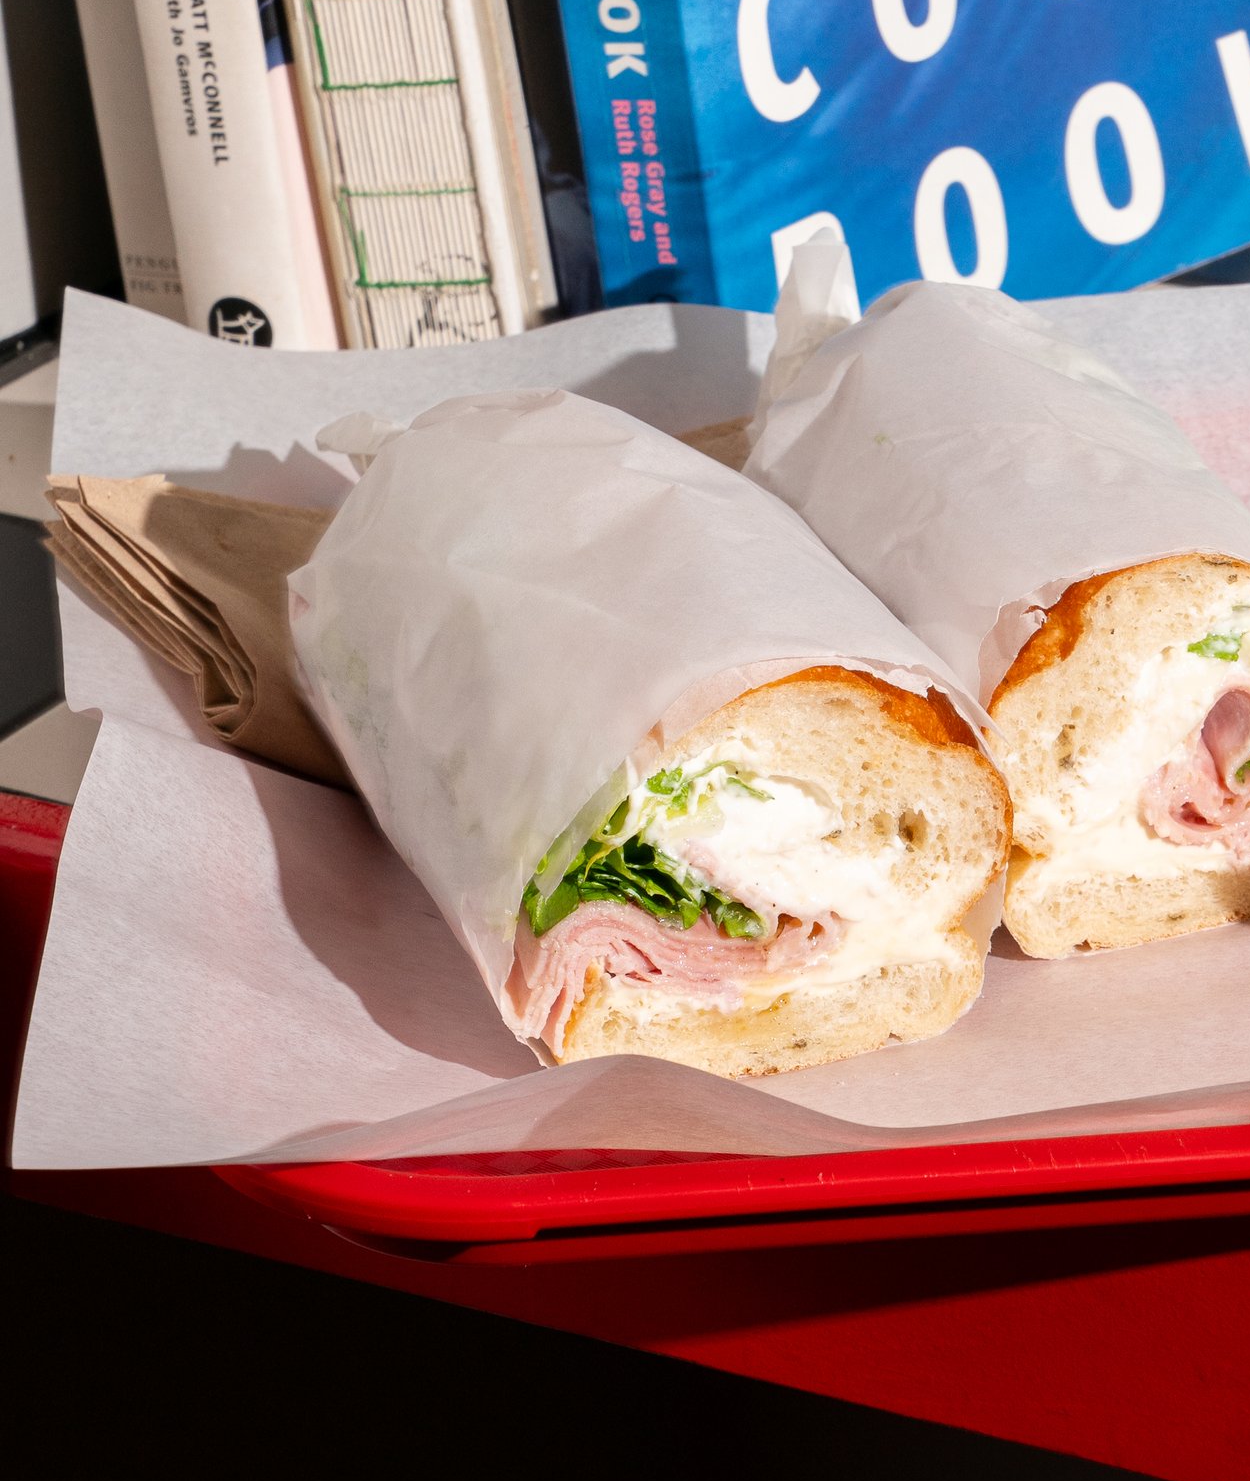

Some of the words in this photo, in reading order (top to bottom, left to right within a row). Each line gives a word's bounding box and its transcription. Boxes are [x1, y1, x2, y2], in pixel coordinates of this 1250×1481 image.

[171, 27, 185, 47] Jo
[176, 54, 198, 137] Gamvros
[611, 99, 638, 155] Ruth
[636, 99, 659, 156] Rose
[618, 161, 646, 242] Rogers
[645, 161, 667, 217] Gray
[653, 222, 677, 265] and
